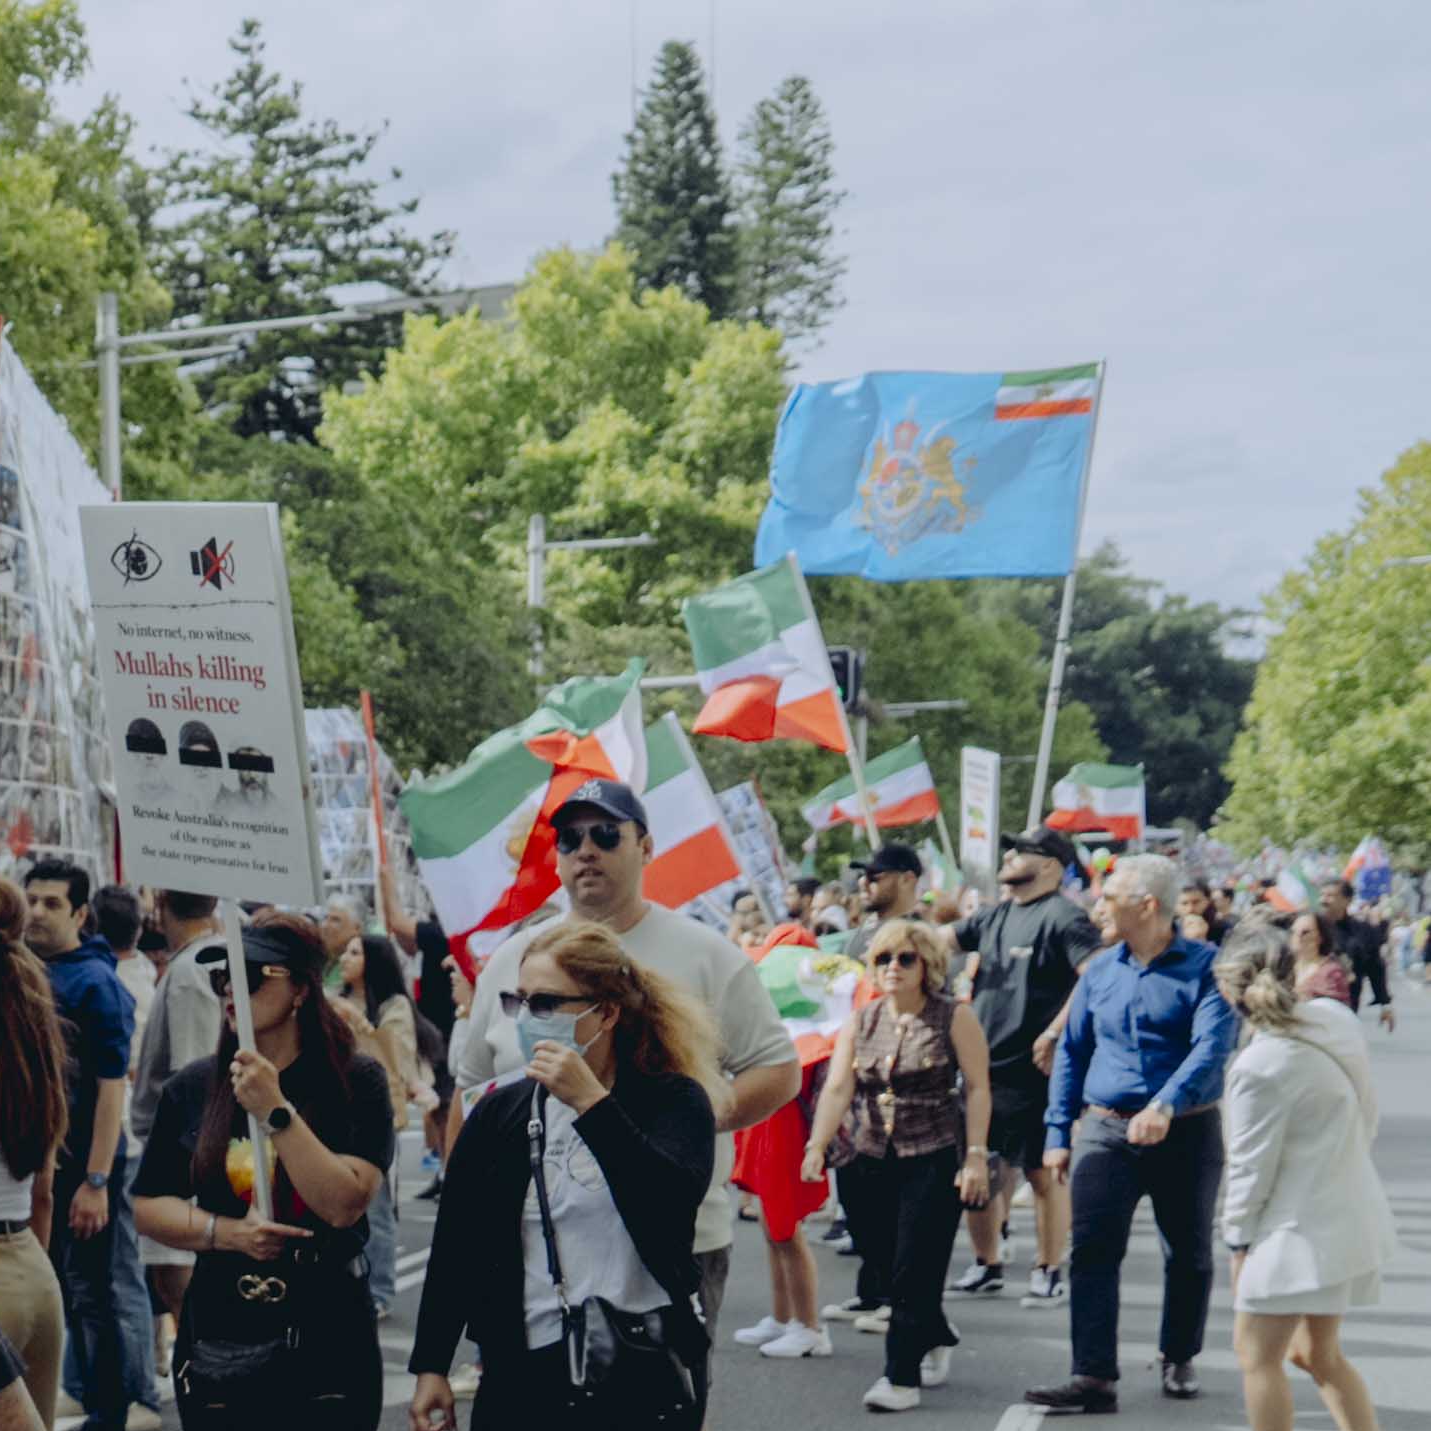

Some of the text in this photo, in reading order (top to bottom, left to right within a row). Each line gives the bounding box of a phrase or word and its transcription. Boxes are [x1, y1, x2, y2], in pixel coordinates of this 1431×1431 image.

[117, 621, 134, 637] No
[136, 623, 187, 641] internet,
[188, 629, 204, 641] no
[113, 649, 267, 690] Mullahs killing
[146, 683, 240, 714] in silence
[132, 805, 289, 836] Revoke Australia's recognition
[170, 830, 251, 850] of the regime as
[159, 847, 180, 861] state
[183, 851, 250, 870] representative
